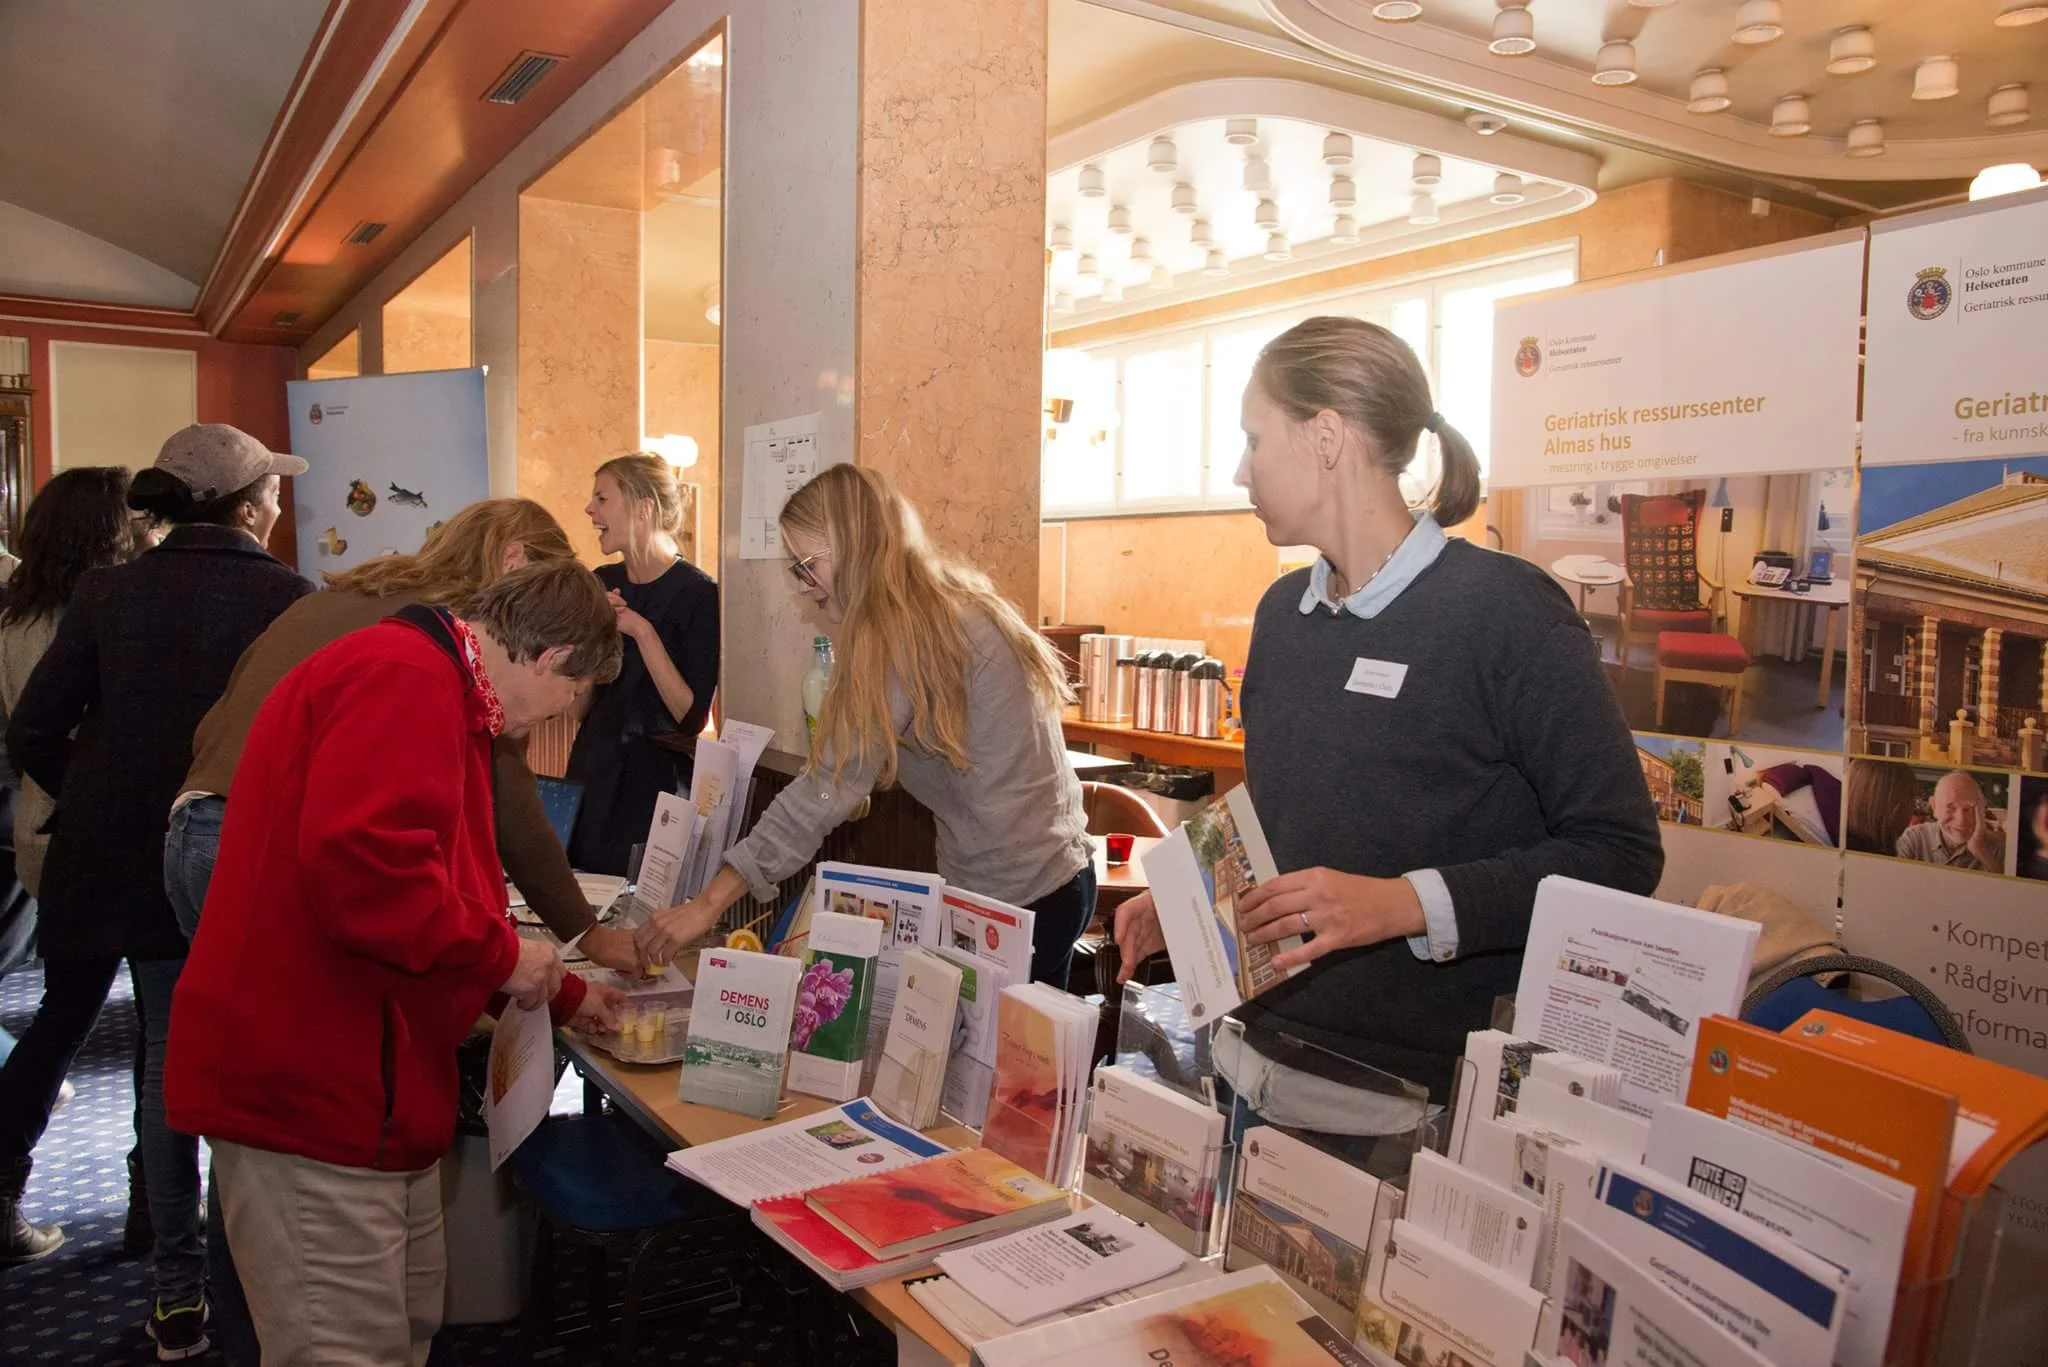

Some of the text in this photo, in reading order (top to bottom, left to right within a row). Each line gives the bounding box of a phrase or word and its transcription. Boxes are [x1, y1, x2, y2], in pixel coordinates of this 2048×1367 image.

[1965, 258, 2046, 279] Oslo kommune
[1965, 275, 2029, 293] Helseetaten
[1964, 295, 2016, 313] Geriatrisk
[1544, 395, 1766, 432] Geriatrisk ressurssenter
[1544, 432, 1631, 456] Almas hus
[1963, 428, 1985, 443] fra
[1550, 458, 1593, 474] mestring
[1601, 455, 1634, 472] trygge
[1637, 452, 1698, 470] omgivelser
[720, 989, 769, 1010] DEMENS
[726, 1008, 767, 1028] I OSLO
[1950, 1009, 2048, 1049] nforma
